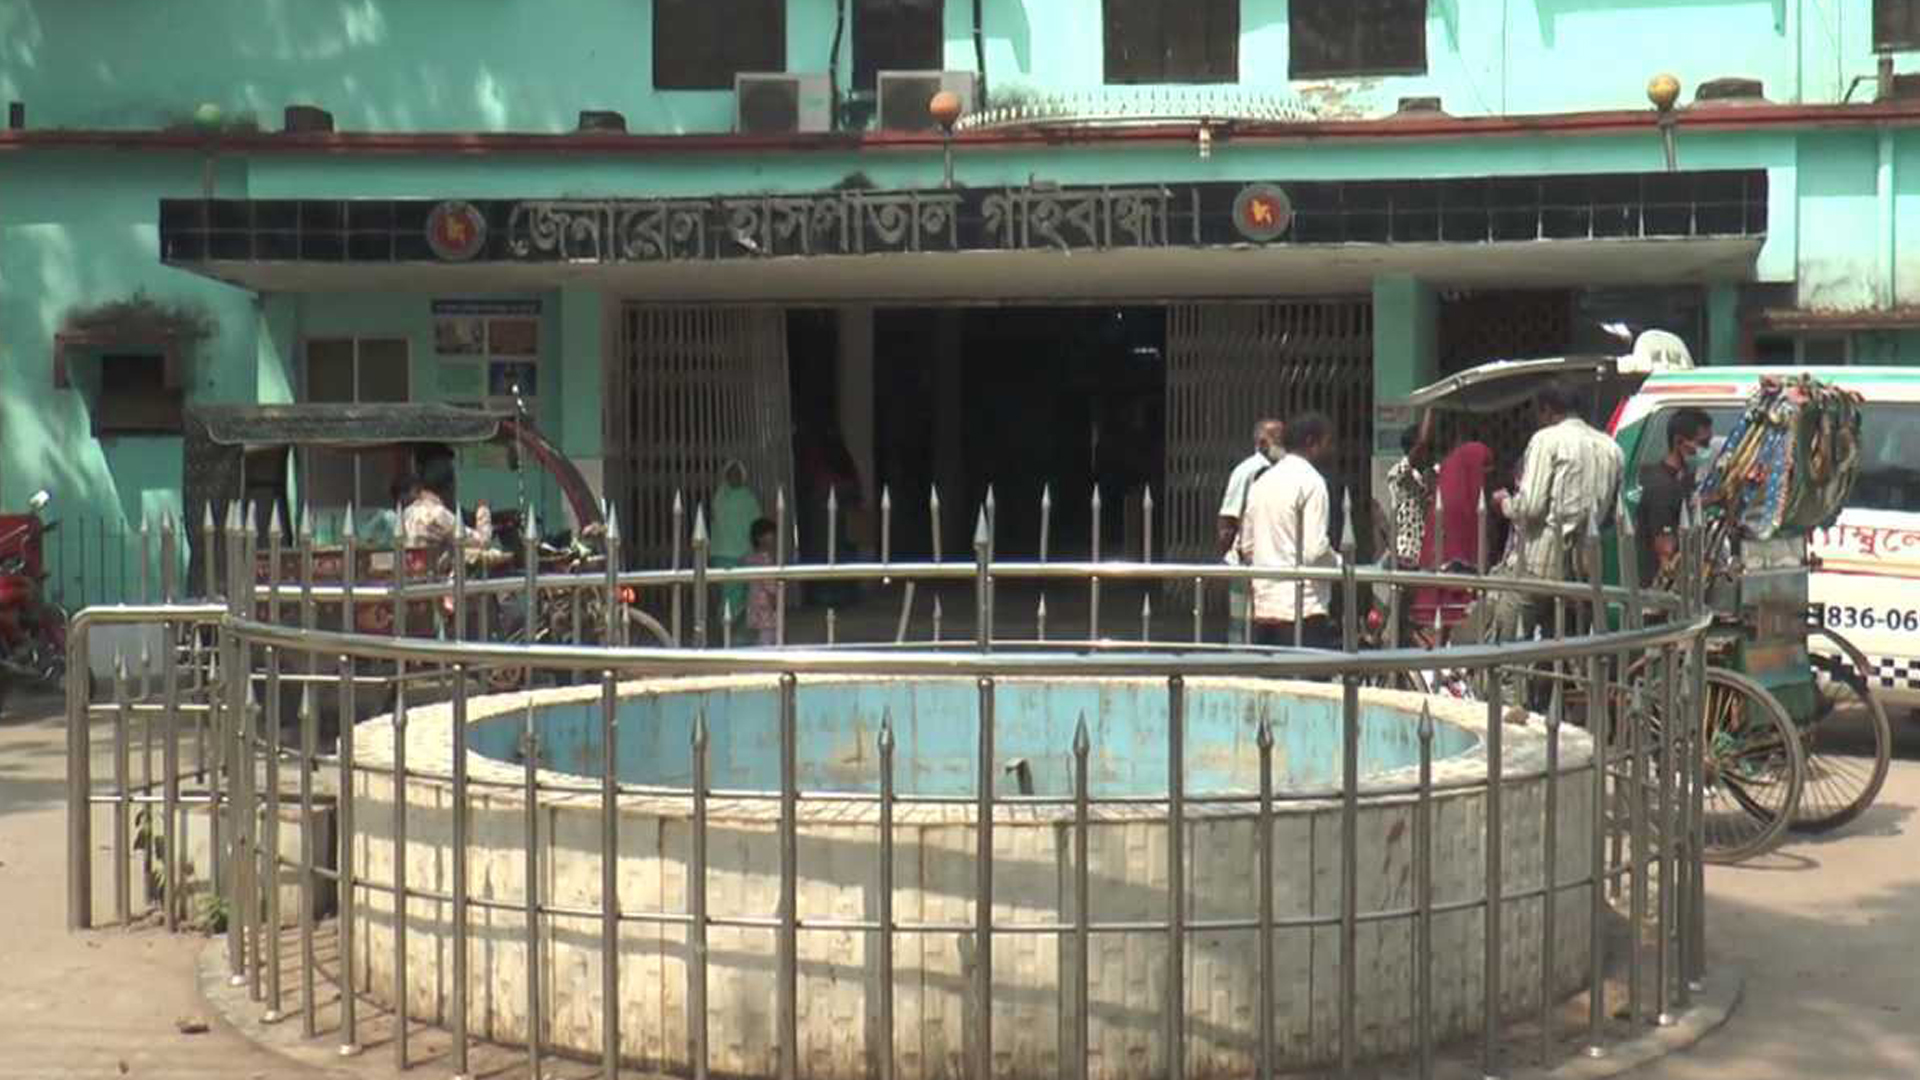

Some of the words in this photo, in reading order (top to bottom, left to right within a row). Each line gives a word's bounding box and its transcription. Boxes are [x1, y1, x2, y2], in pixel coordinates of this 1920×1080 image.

[508, 198, 706, 260] জেনারেল
[722, 189, 963, 257] হাসপাতাল
[1827, 605, 1920, 632] 836-06
